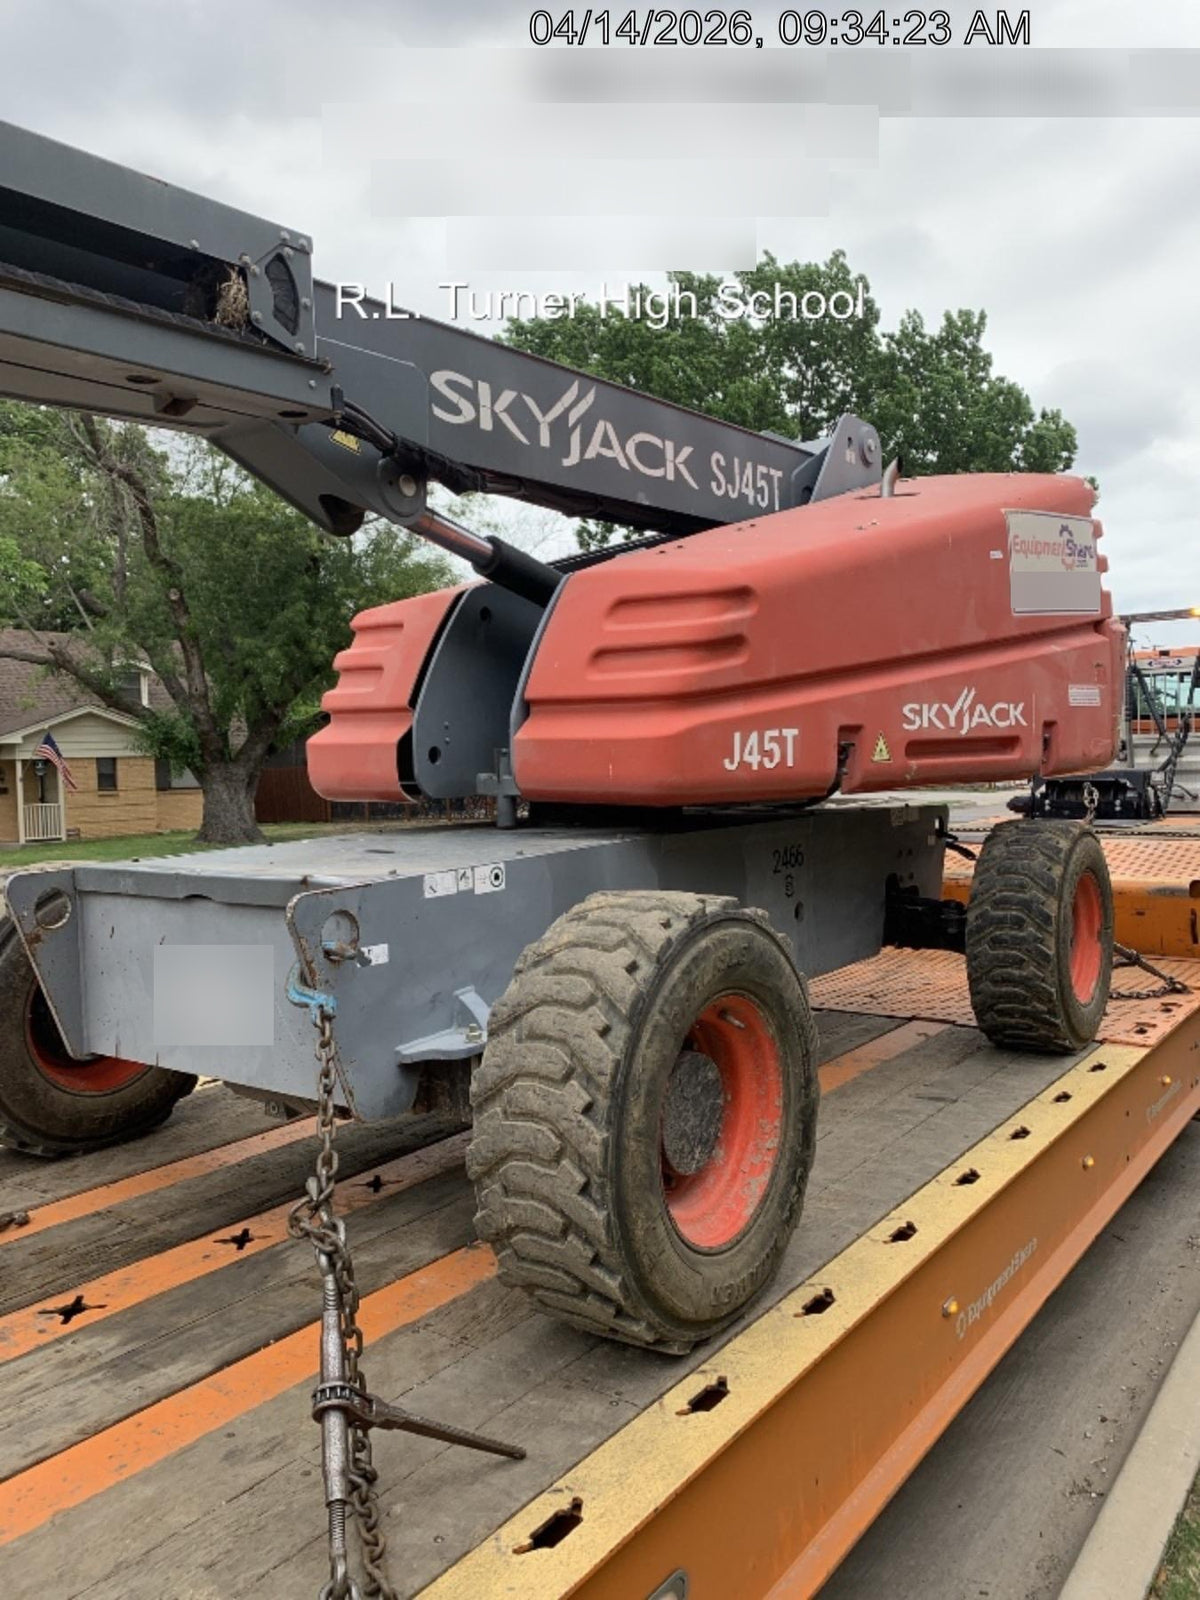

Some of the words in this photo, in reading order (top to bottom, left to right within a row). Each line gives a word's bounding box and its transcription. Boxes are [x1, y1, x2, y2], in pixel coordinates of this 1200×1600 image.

[429, 370, 699, 490] SKYJACK
[711, 451, 783, 511] SJ45T
[902, 686, 1028, 736] SKYJACK
[723, 728, 799, 771] J45T
[773, 844, 804, 874] 2466
